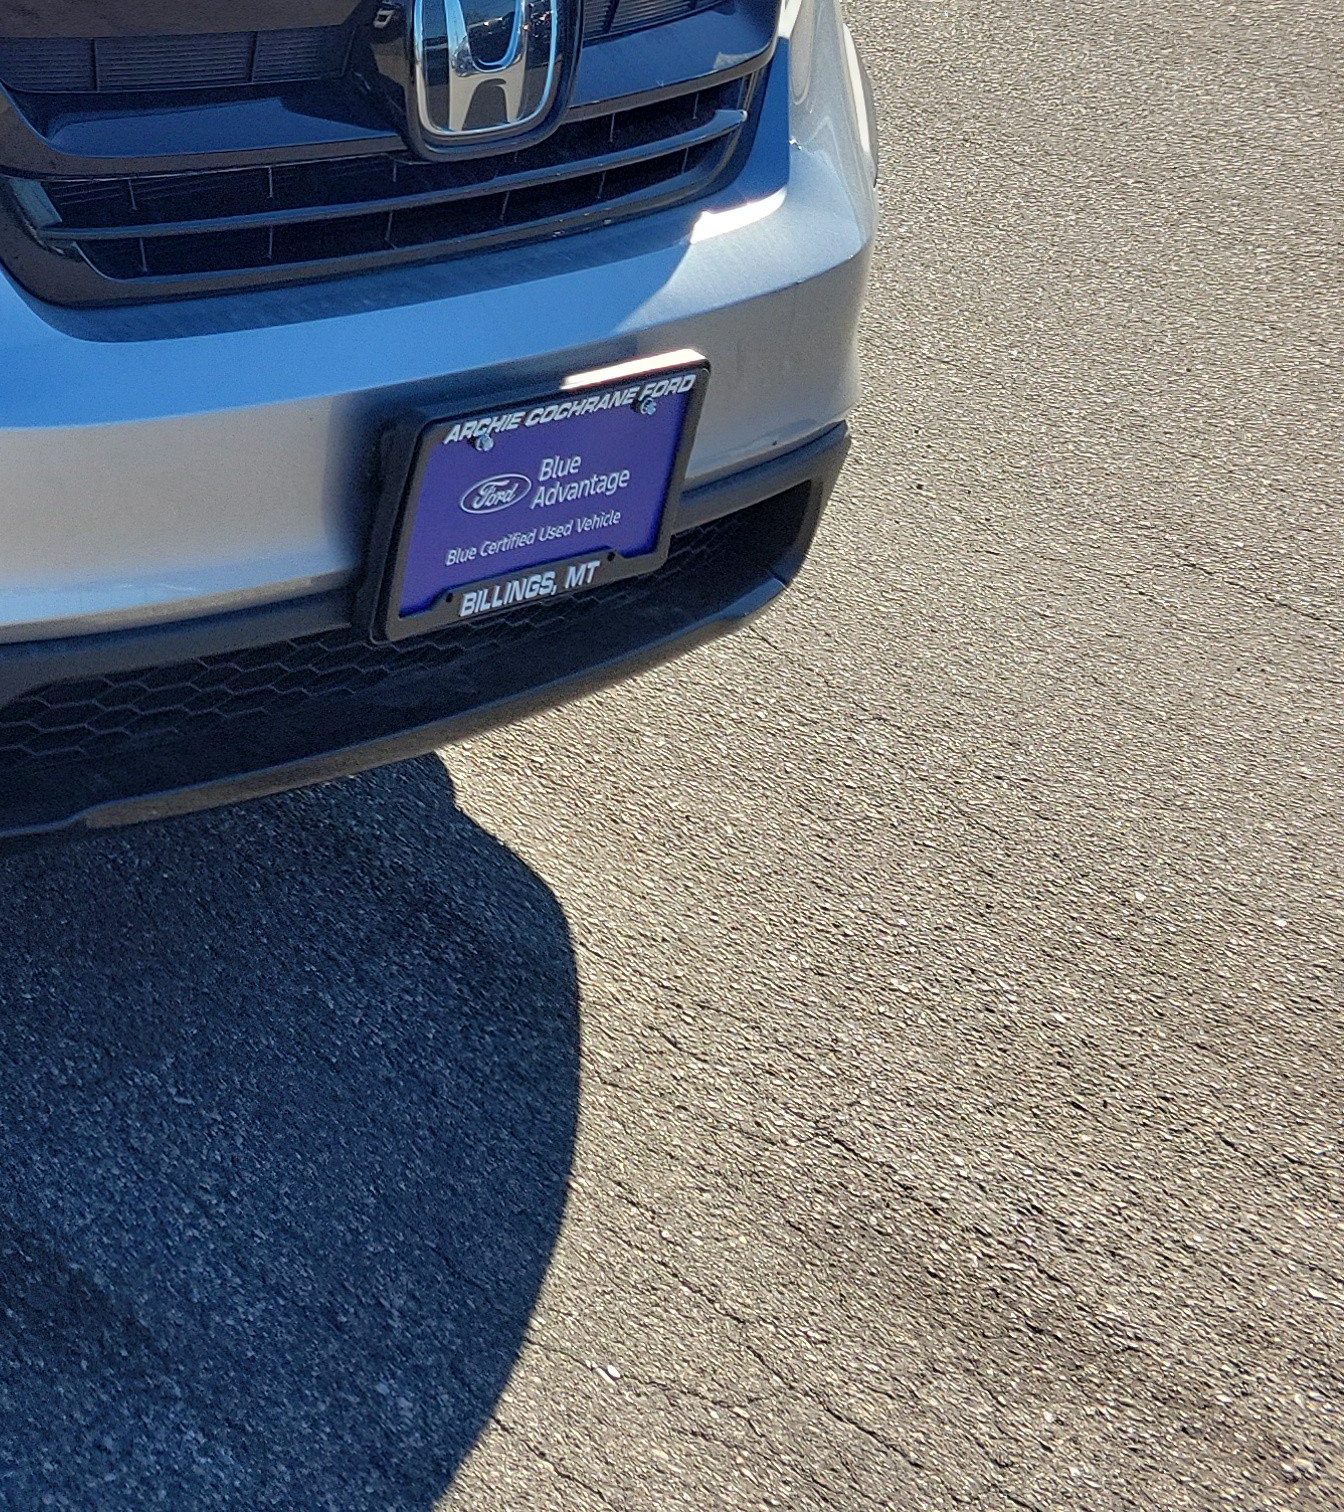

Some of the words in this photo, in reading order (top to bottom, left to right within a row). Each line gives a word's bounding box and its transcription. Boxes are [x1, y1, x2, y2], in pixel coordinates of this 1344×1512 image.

[443, 411, 524, 445] ARCHIE
[525, 387, 640, 428] COCHRANE
[639, 374, 697, 400] FORD
[530, 469, 630, 510] Advantage
[538, 455, 581, 482] Blue
[472, 479, 518, 509] Ford
[445, 547, 477, 566] Blue
[480, 528, 536, 557] Certified
[539, 520, 574, 542] Used
[577, 510, 621, 533] Vehicle
[459, 571, 558, 617] BILLINGS,
[564, 560, 601, 589] MT
